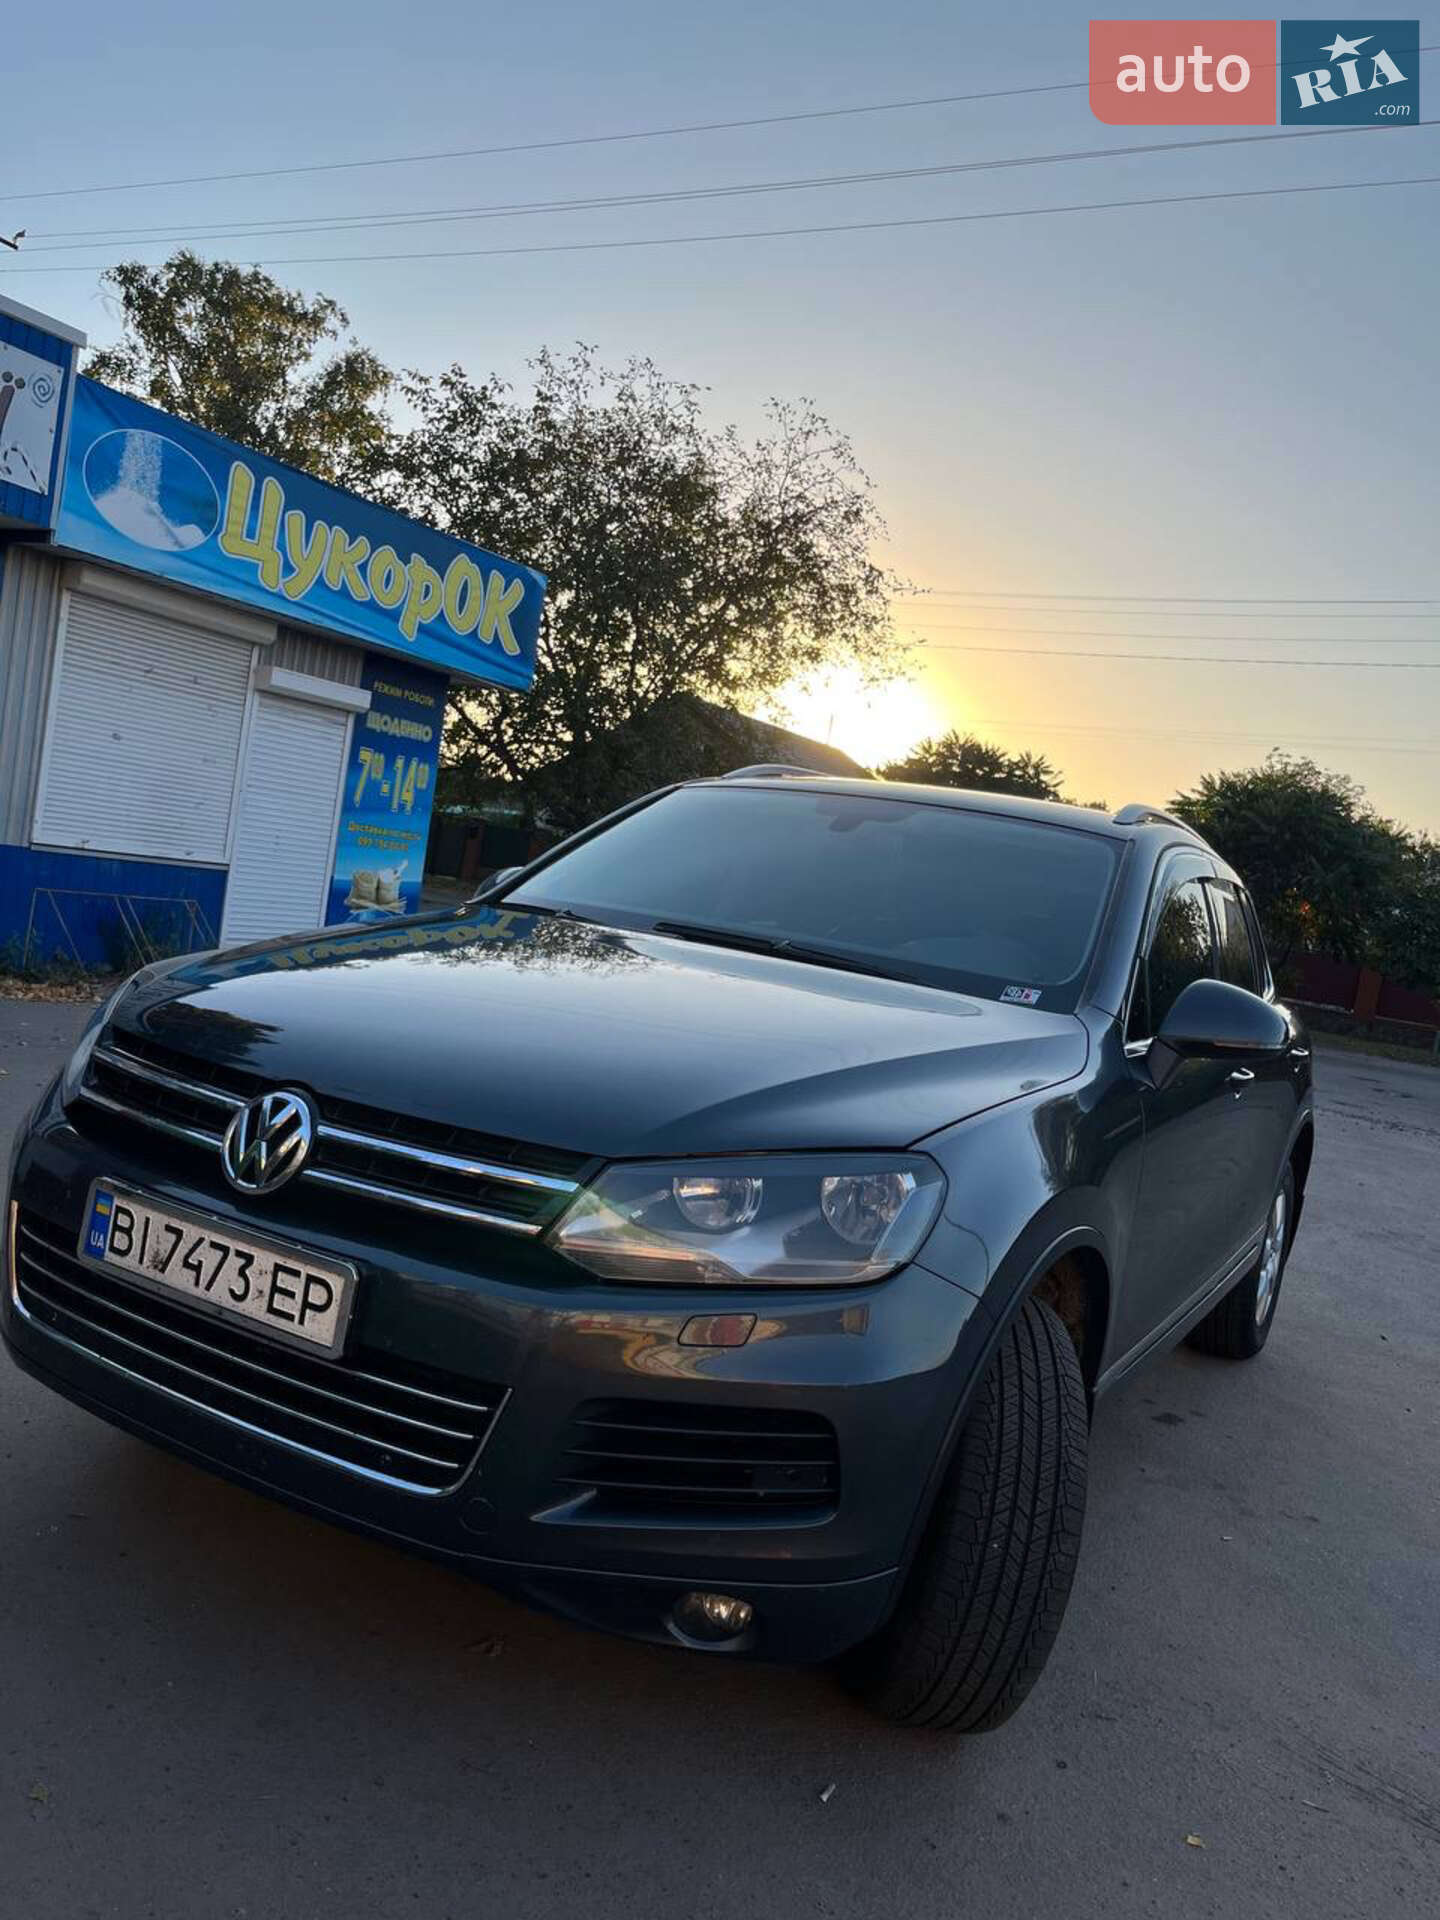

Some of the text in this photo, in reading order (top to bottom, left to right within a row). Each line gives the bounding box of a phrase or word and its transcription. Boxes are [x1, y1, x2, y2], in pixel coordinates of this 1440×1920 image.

[366, 709, 433, 743] ЩОДЕННО
[89, 1232, 105, 1250] UA
[157, 1223, 255, 1303] 7473
